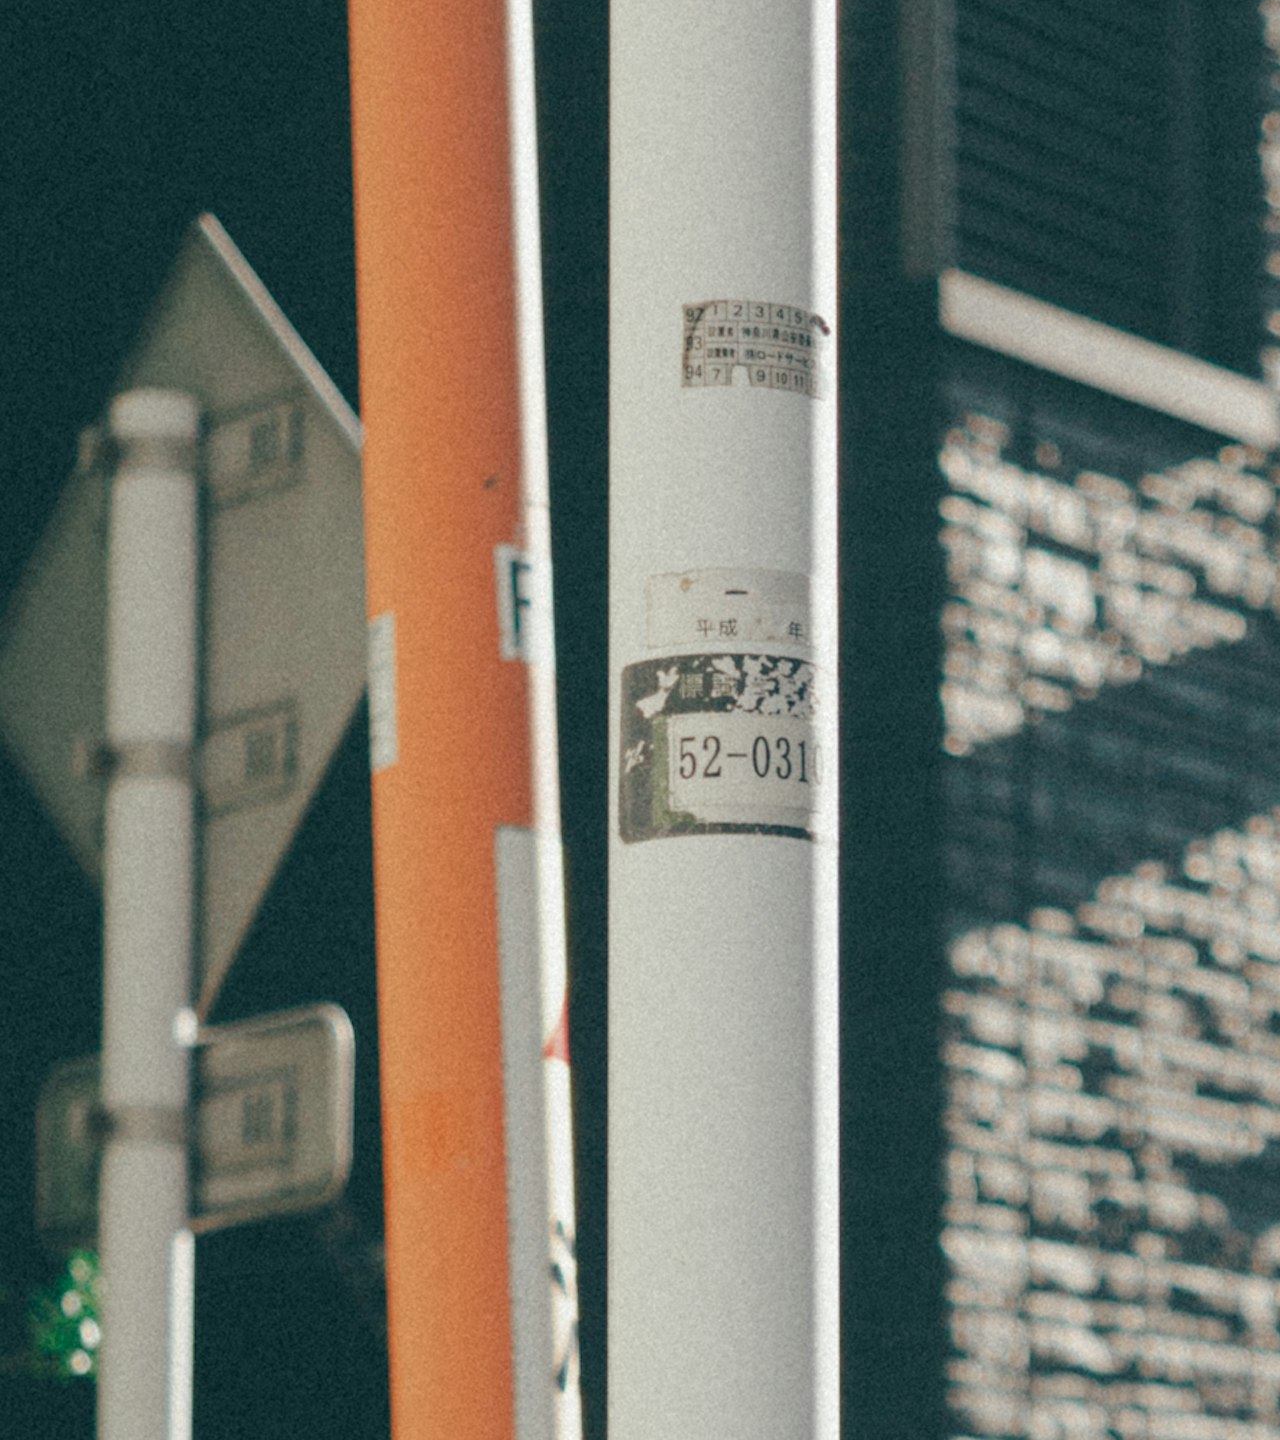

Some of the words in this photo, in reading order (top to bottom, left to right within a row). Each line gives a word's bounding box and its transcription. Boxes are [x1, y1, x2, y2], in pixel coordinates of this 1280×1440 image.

[732, 304, 744, 318] 2
[755, 305, 765, 319] 3
[776, 308, 785, 321] 4
[794, 311, 803, 325] 5
[712, 368, 721, 381] 7
[755, 369, 766, 382] 9
[775, 372, 788, 385] 10
[696, 619, 738, 638] 平成
